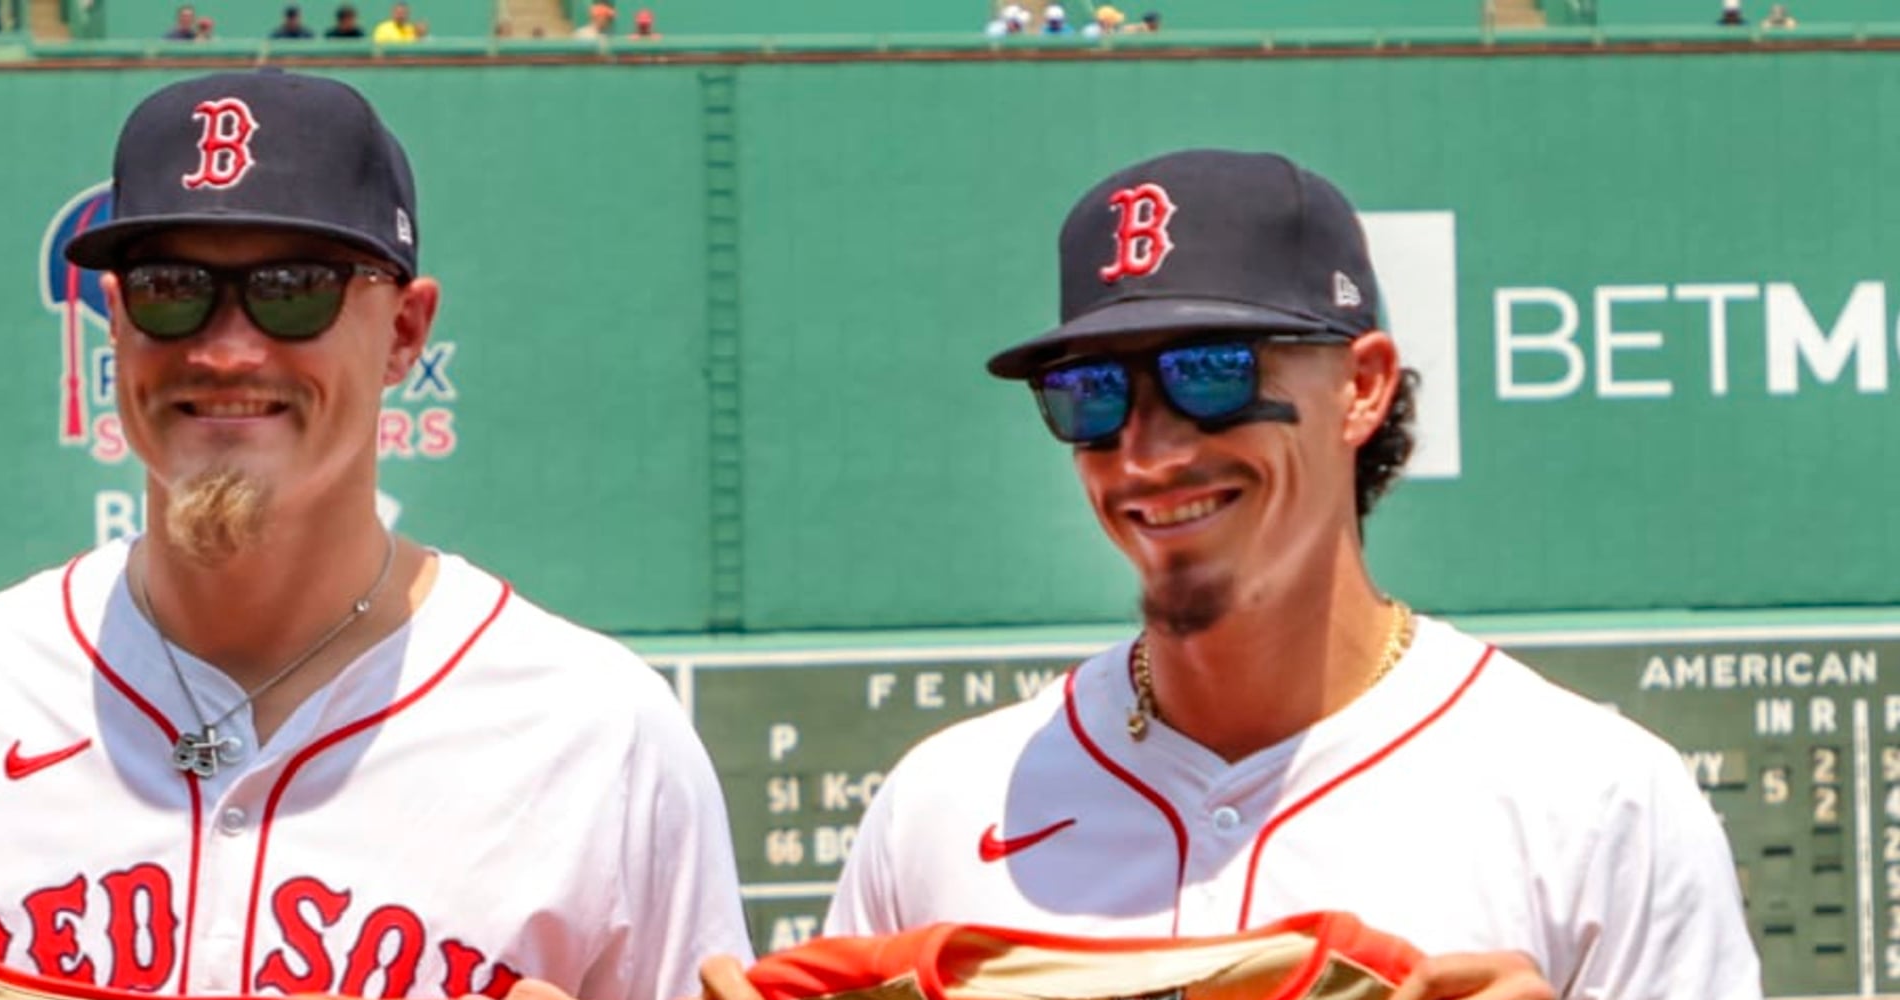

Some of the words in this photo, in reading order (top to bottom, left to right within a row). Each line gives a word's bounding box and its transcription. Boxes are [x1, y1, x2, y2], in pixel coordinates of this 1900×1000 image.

[183, 97, 259, 189] B
[1100, 183, 1177, 282] B
[1494, 281, 1900, 400] BETM
[1639, 650, 1877, 690] AMERICAN
[1756, 699, 1793, 735] IN
[1810, 698, 1837, 733] R
[769, 722, 798, 761] P
[1812, 748, 1837, 783] 2
[1812, 787, 1838, 822] 2
